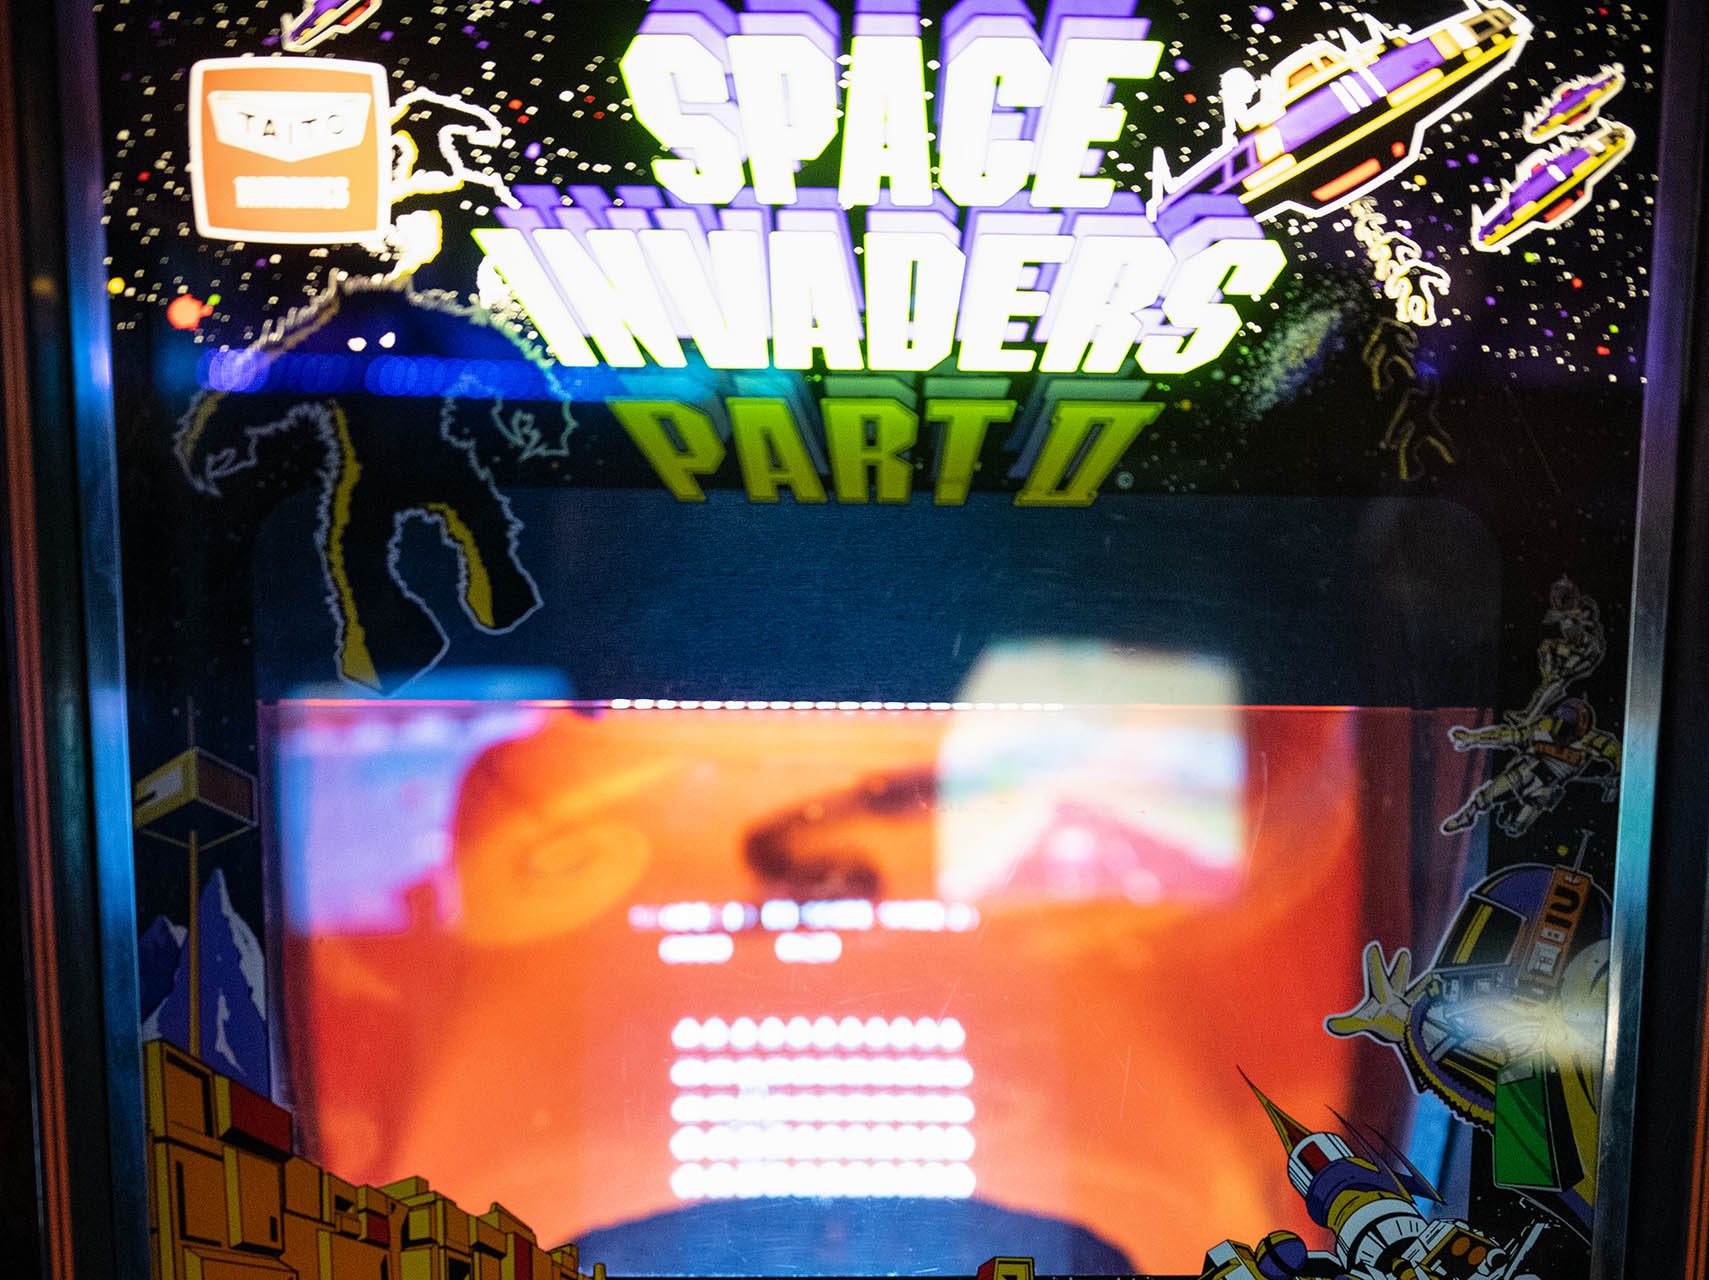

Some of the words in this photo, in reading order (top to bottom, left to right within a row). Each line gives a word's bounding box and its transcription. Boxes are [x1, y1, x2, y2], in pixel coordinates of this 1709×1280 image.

[236, 110, 345, 146] TAITO
[619, 32, 1165, 208] SPACE
[471, 227, 1288, 375] INVADERS
[604, 396, 1019, 506] PART
